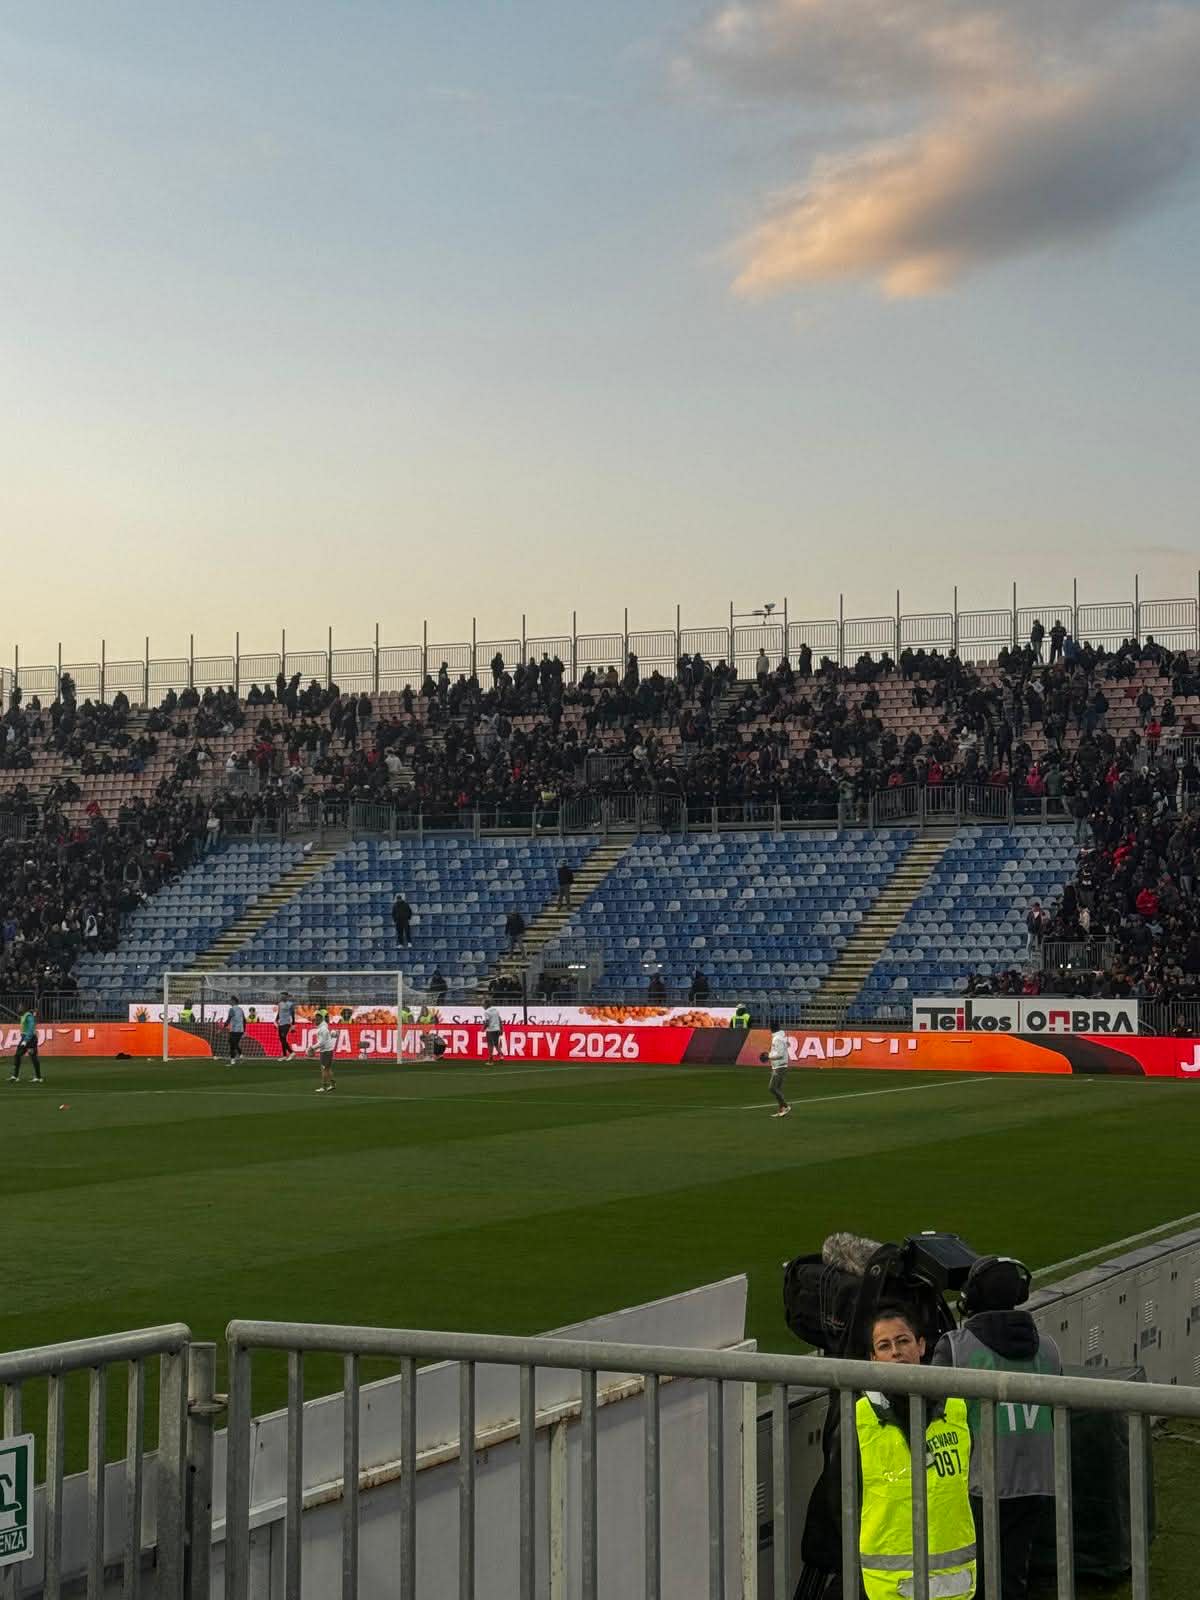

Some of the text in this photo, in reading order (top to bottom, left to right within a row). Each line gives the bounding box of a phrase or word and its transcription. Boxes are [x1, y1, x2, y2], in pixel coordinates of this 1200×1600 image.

[916, 1000, 1012, 1031] Teikos
[568, 1032, 640, 1058] 2026
[1000, 1402, 1040, 1432] TV
[927, 1431, 959, 1452] TEWARD
[934, 1449, 962, 1478] 097
